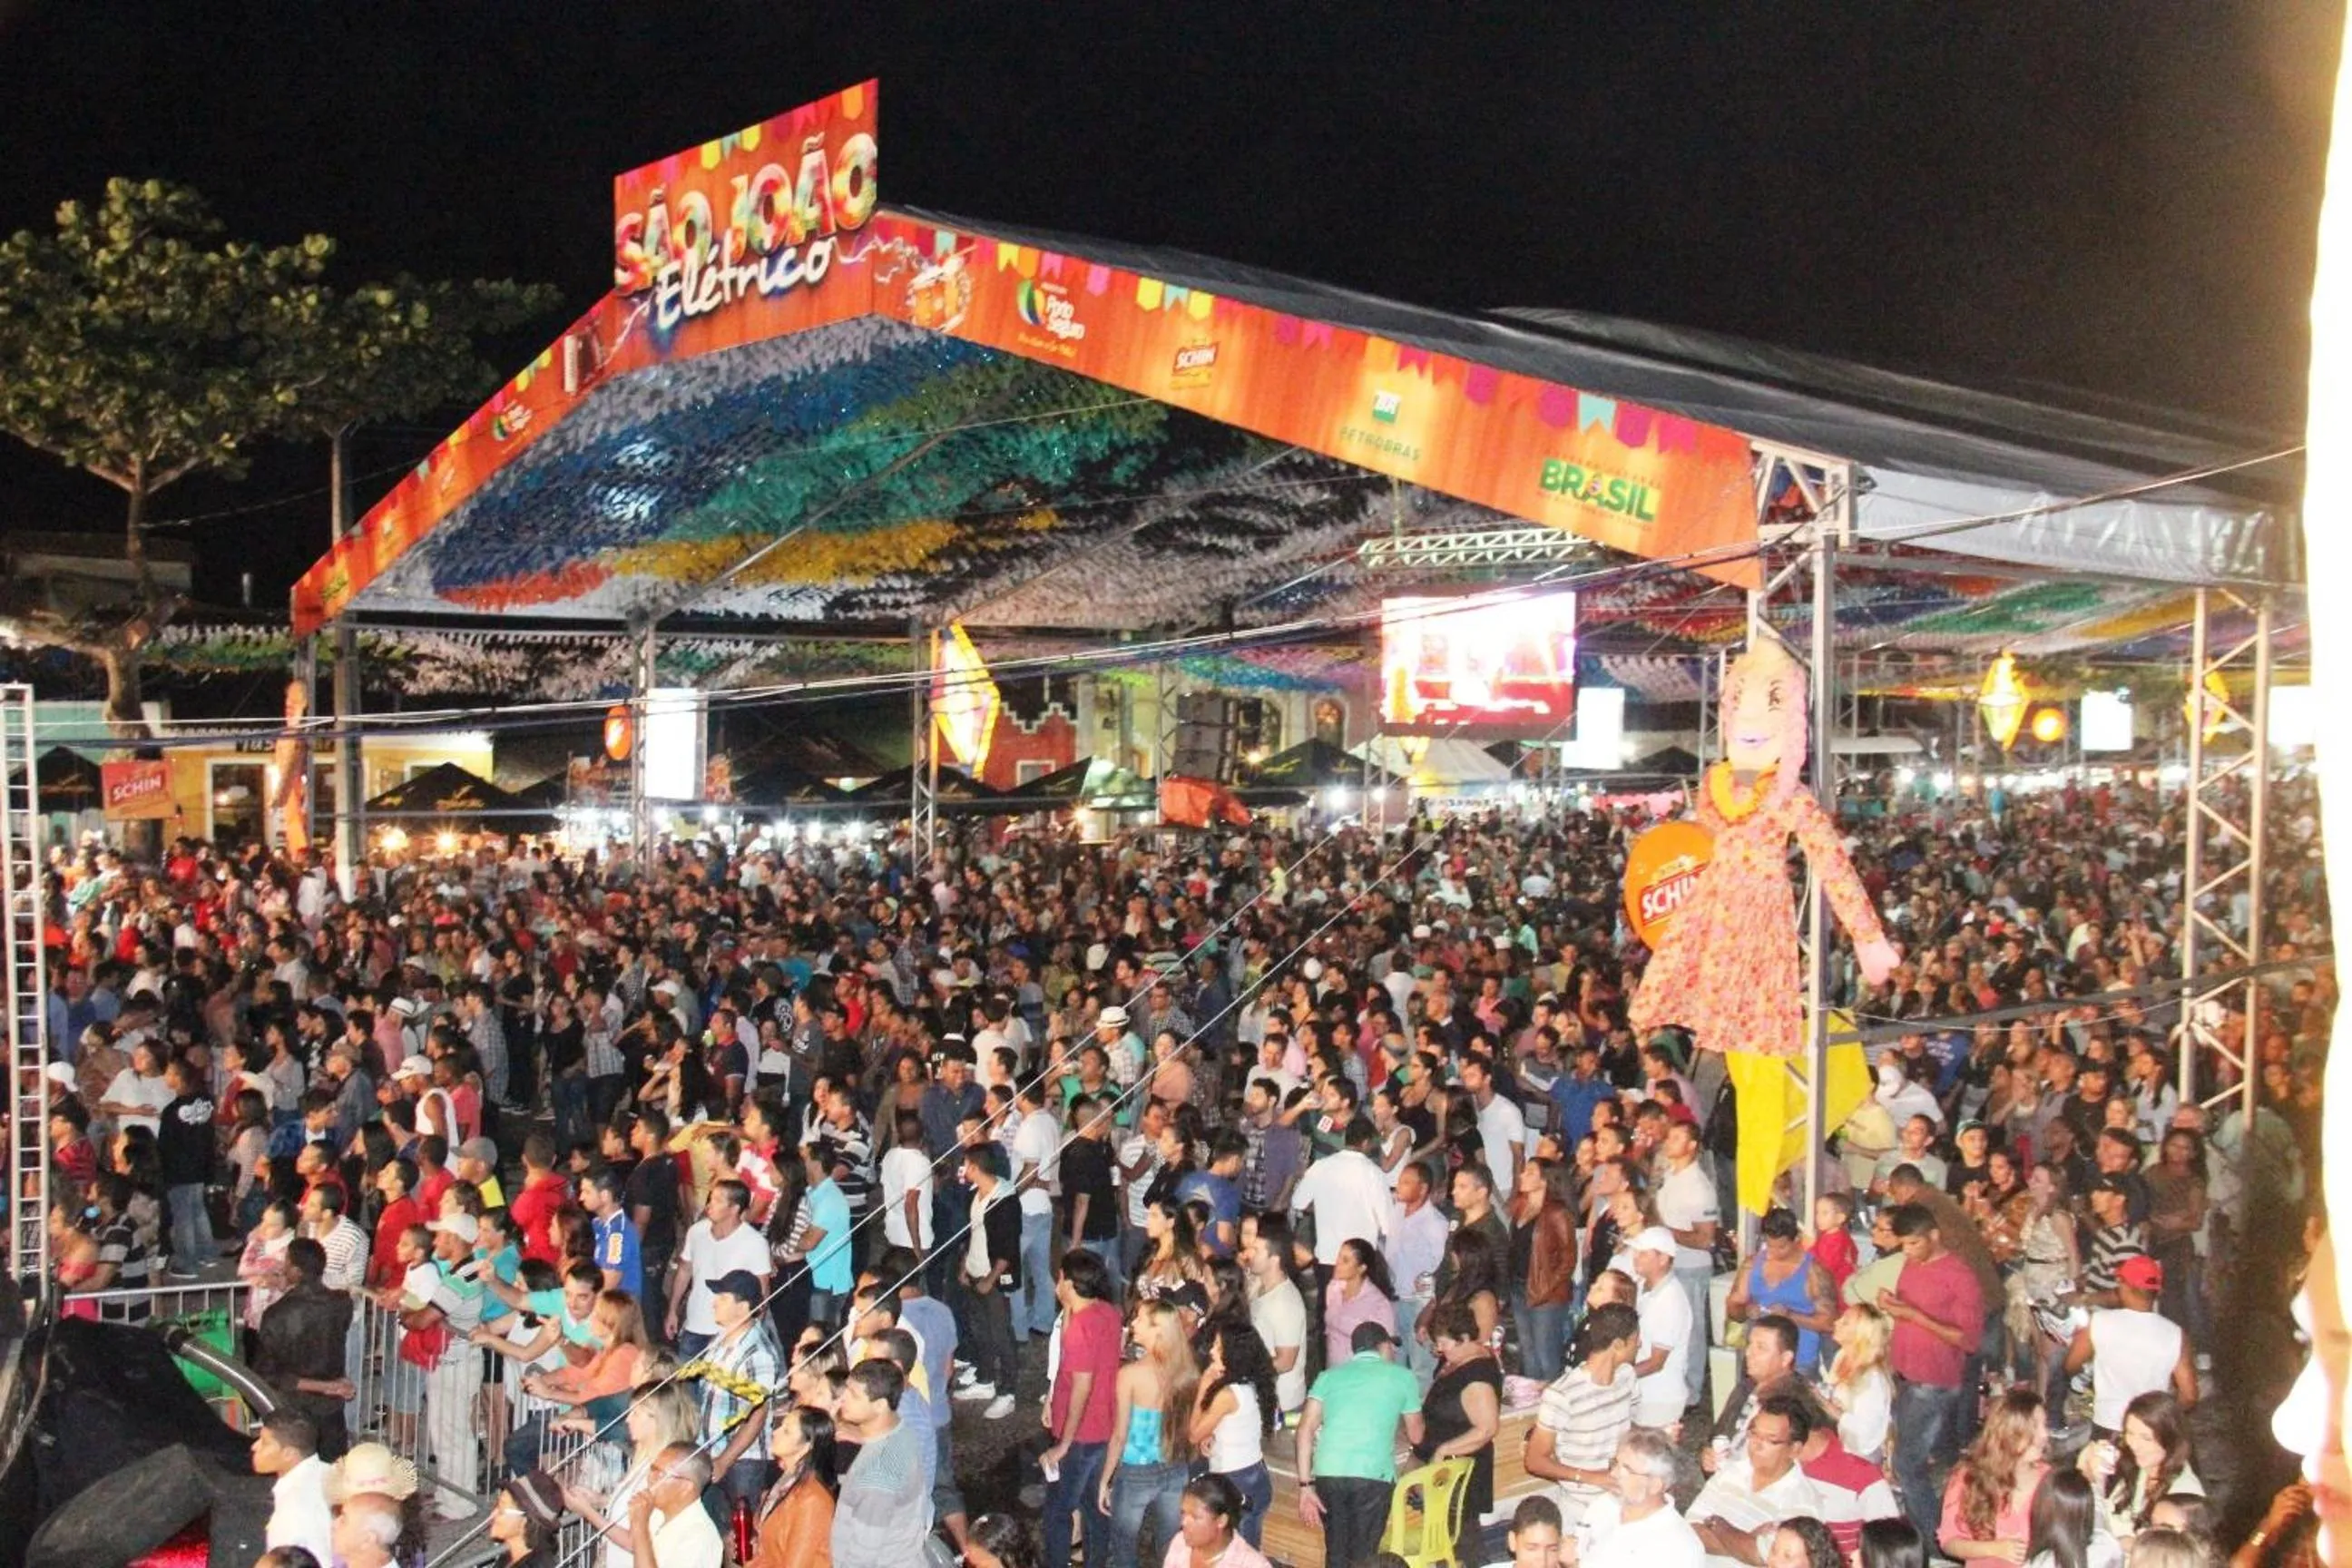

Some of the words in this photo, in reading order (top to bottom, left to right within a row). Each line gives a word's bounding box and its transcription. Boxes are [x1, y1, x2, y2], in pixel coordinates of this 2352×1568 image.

[614, 182, 713, 296] SÃO
[730, 131, 877, 265] JOÃO
[655, 227, 836, 329] Elétrico
[1339, 426, 1423, 461] PETROBRAS
[1540, 457, 1656, 522] BRASIL
[112, 773, 162, 802] SCHIN
[1641, 874, 1697, 920] SCHI
